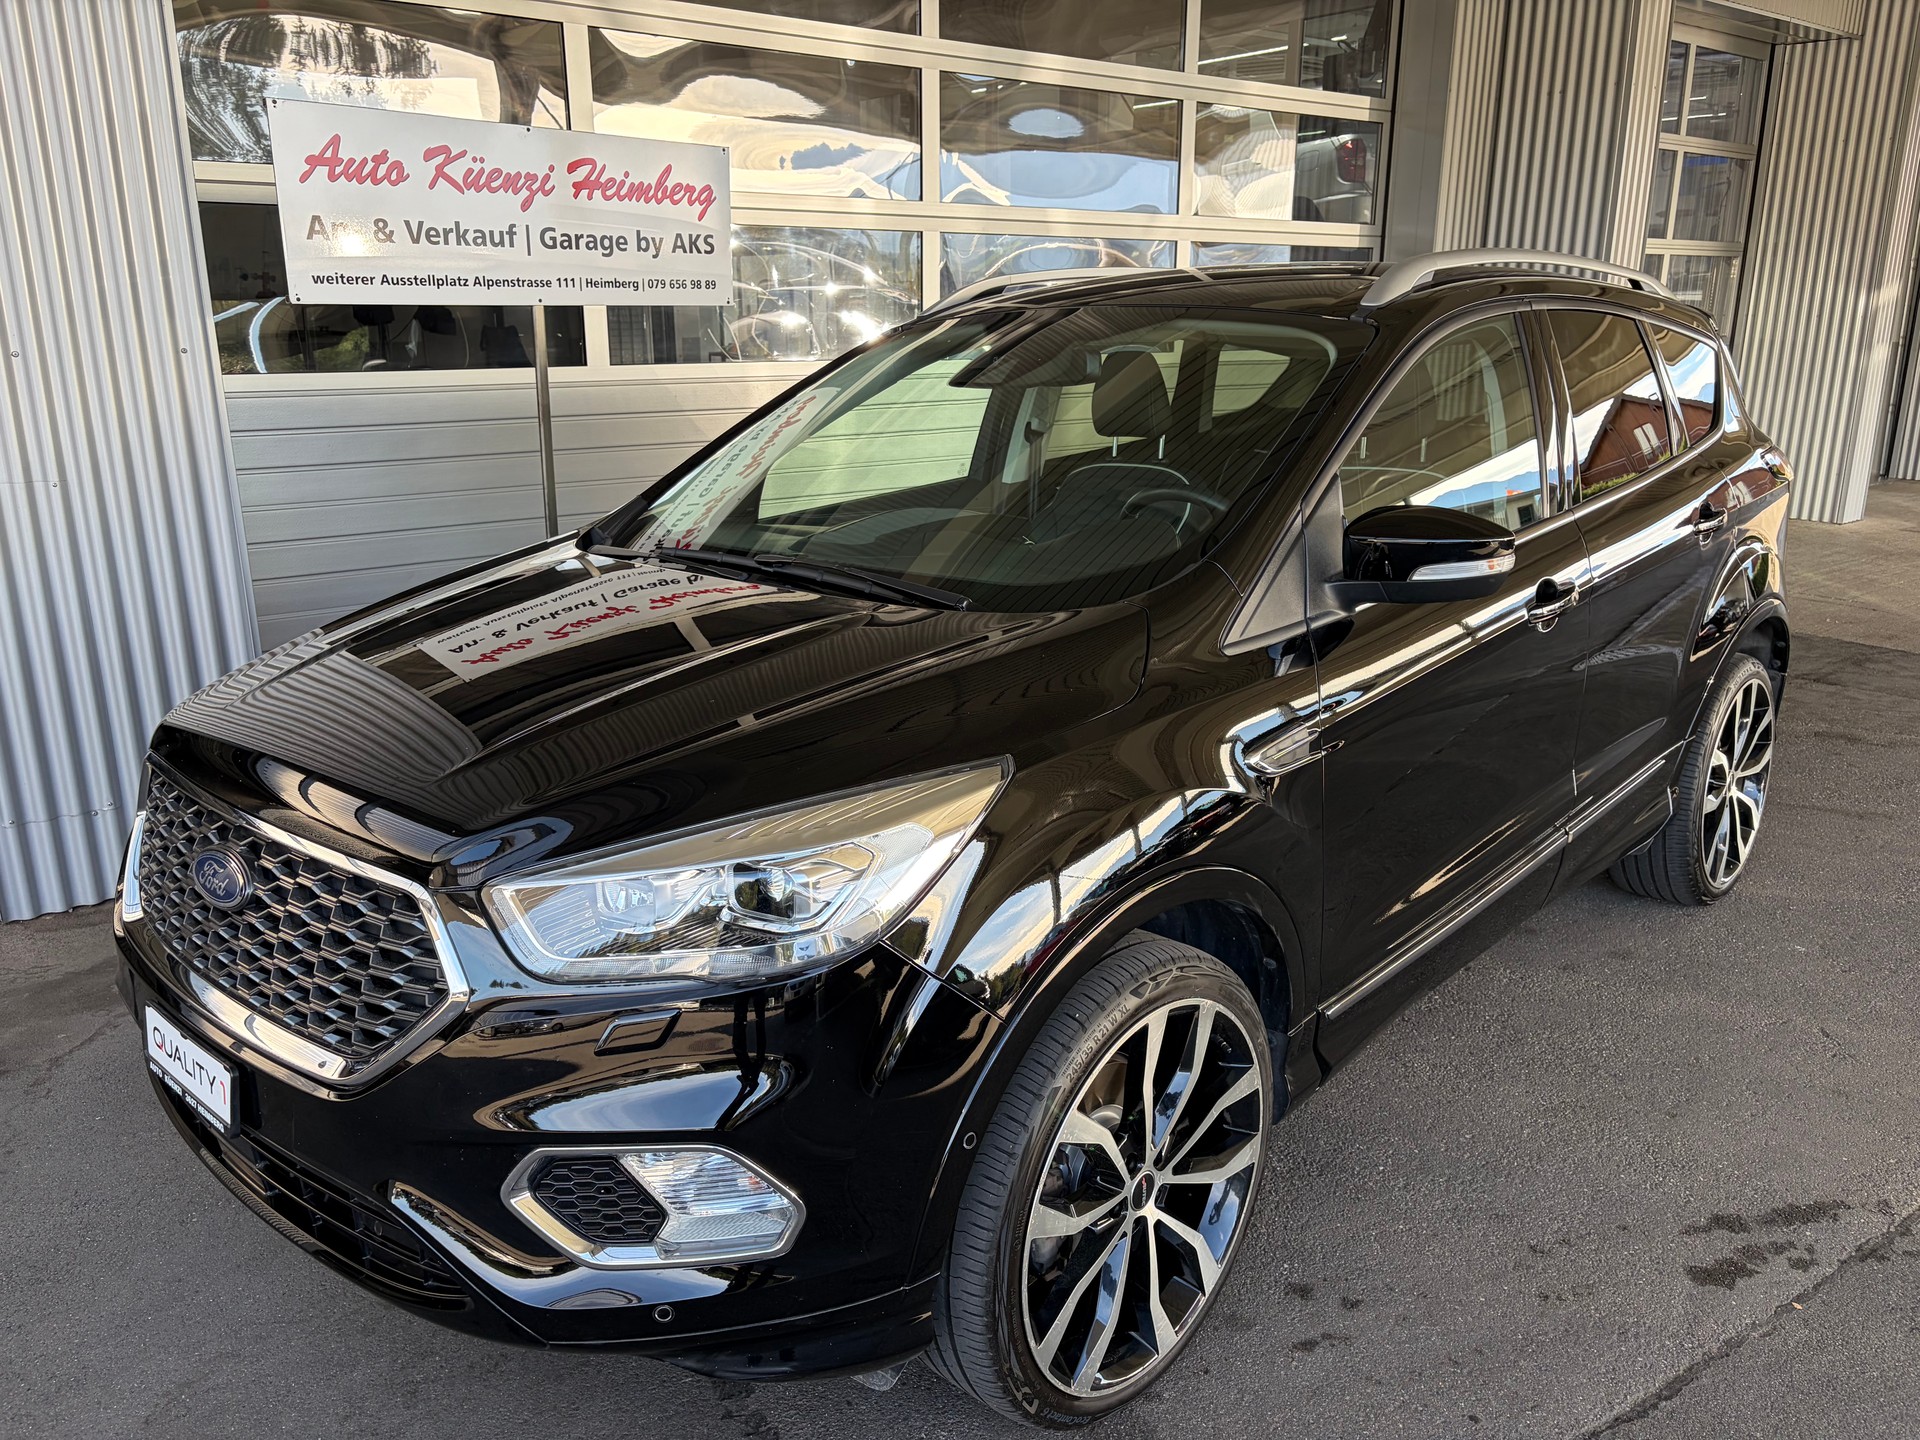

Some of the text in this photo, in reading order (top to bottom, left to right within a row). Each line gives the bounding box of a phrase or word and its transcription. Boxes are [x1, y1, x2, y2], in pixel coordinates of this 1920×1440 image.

[299, 133, 716, 221] Auto Küenzi Heimberg
[373, 217, 396, 244] &
[403, 220, 517, 248] Verkauf
[539, 227, 628, 258] Garage
[636, 230, 664, 258] by
[671, 234, 715, 255] AKS
[312, 272, 375, 286] weiterer
[380, 273, 469, 290] Ausstellplatz
[473, 275, 552, 290] Alpenstrasse
[556, 277, 576, 288] 111
[585, 277, 639, 291] Heimberg
[647, 278, 666, 290] 079
[669, 279, 687, 290] 656
[689, 279, 703, 290] 98
[704, 279, 717, 290] 89
[199, 861, 229, 896] Ford
[1066, 1044, 1094, 1083] 245/35
